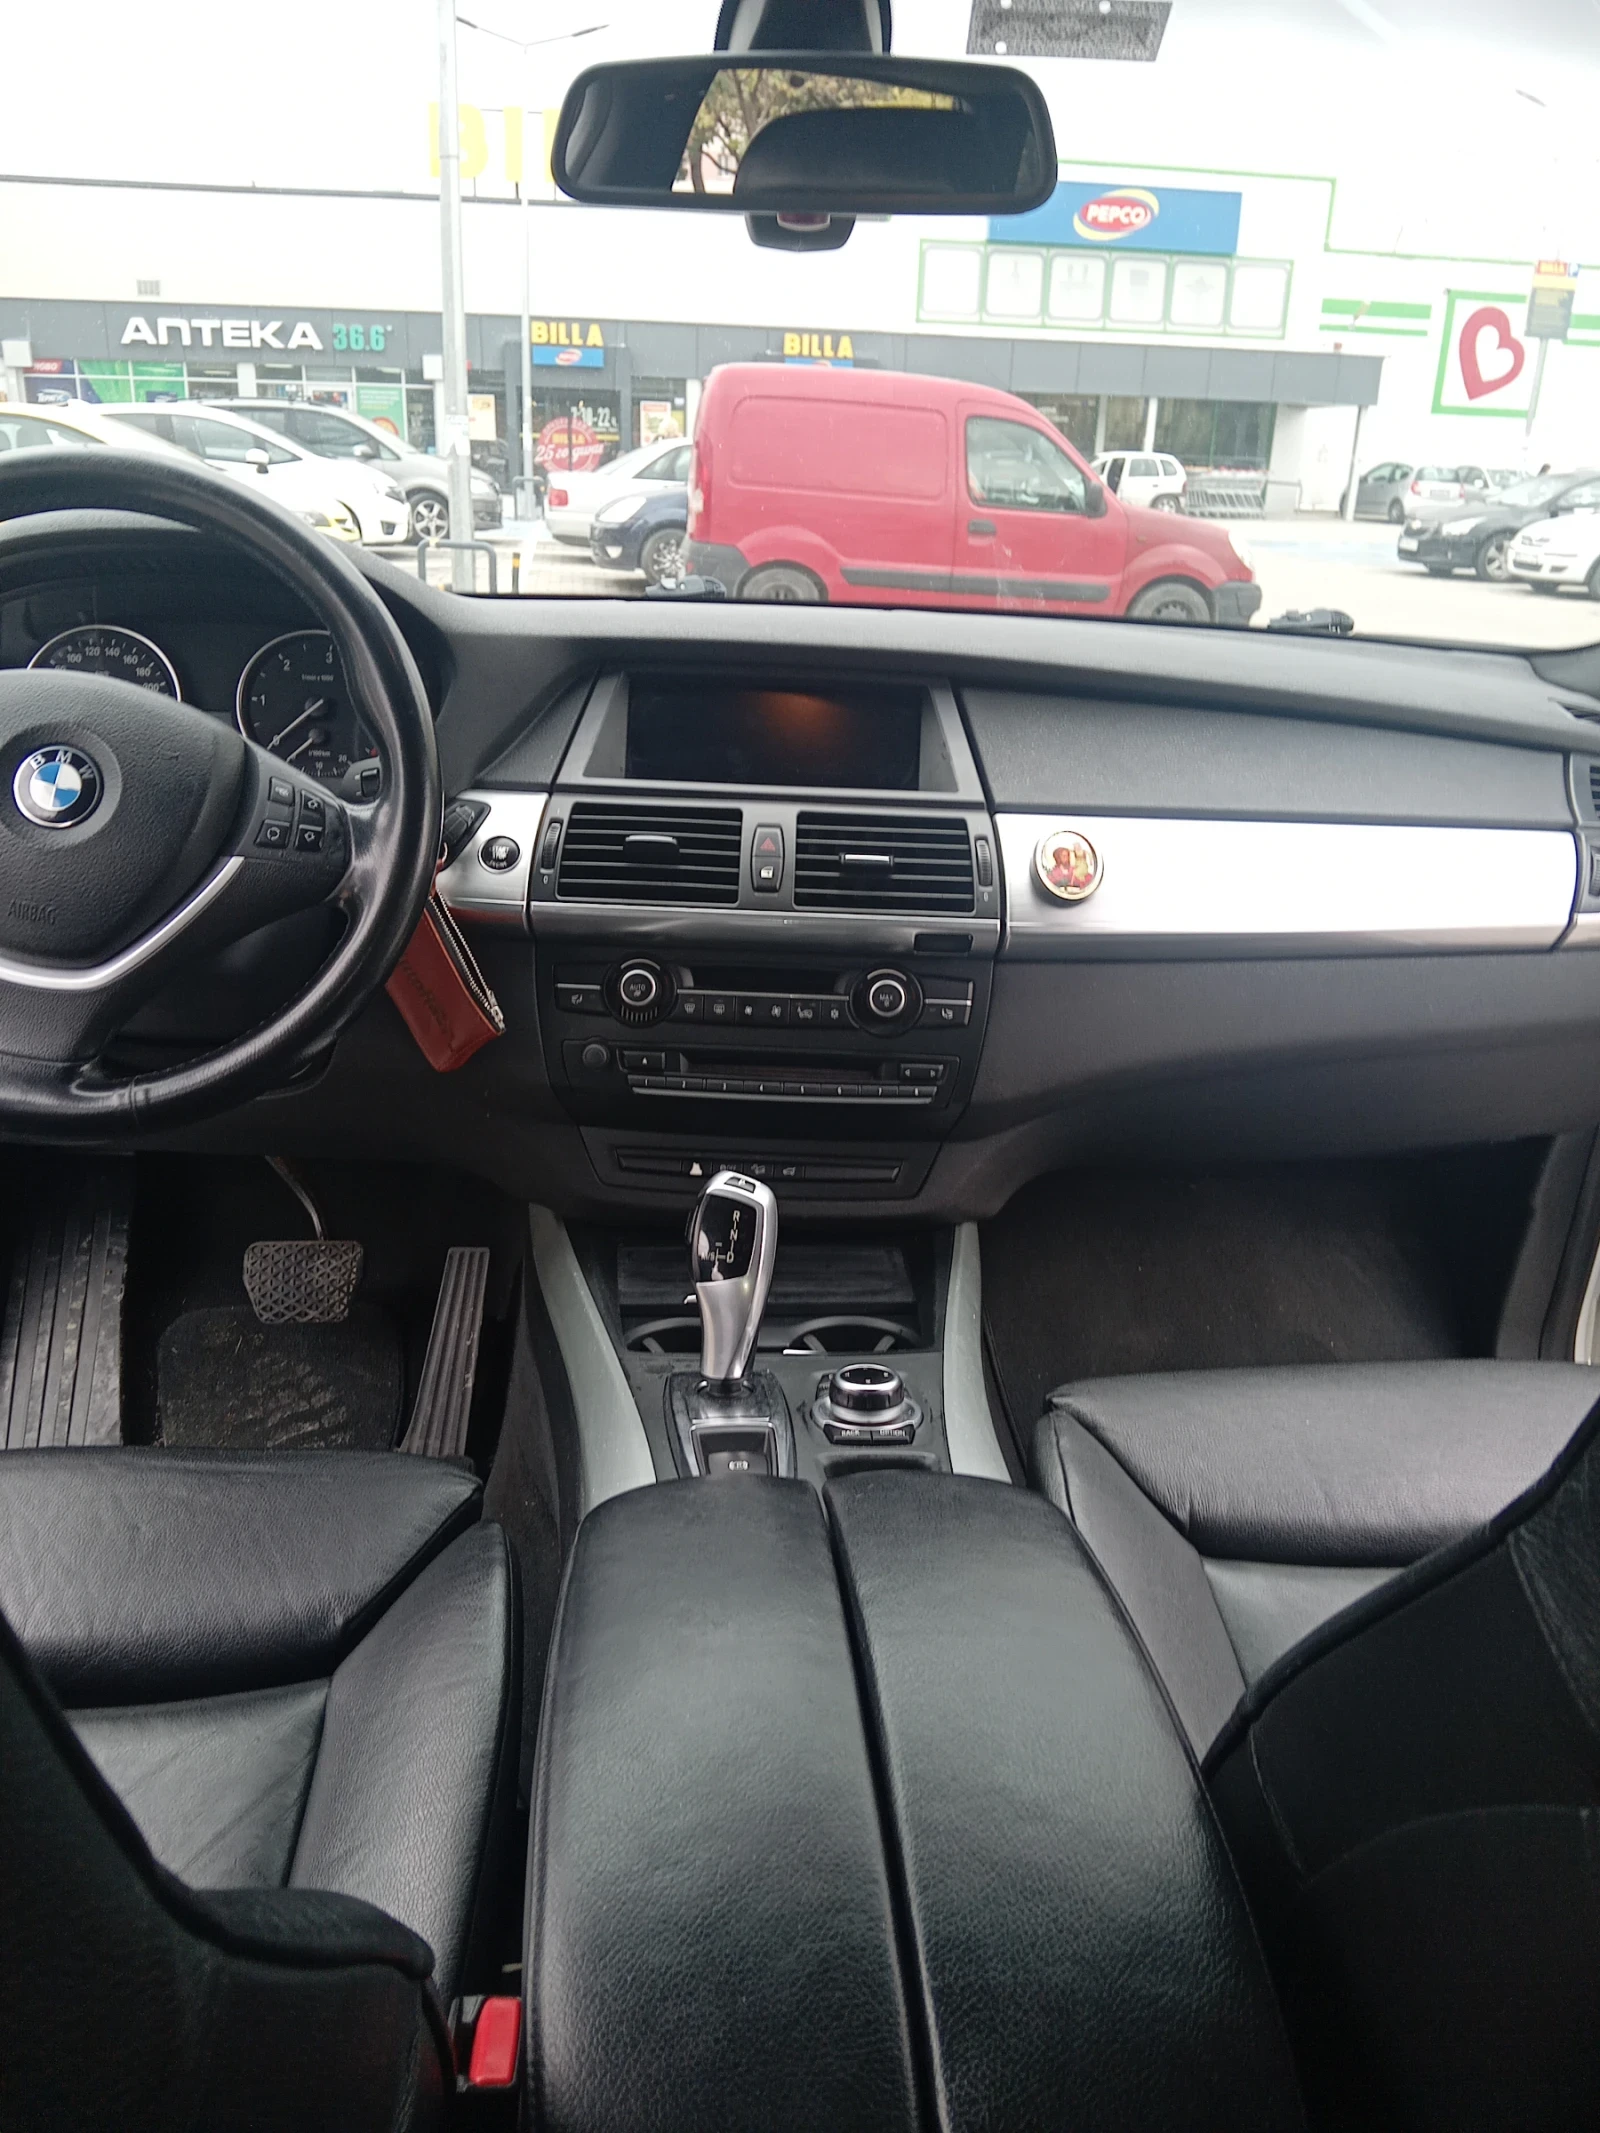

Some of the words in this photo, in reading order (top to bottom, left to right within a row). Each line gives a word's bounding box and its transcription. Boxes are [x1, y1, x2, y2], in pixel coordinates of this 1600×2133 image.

[1086, 203, 1146, 225] PEPCO
[120, 317, 323, 351] АПТЕКА
[531, 320, 604, 347] BILLA
[783, 332, 854, 359] BILLA
[534, 443, 556, 462] 25
[85, 646, 100, 657] 120
[104, 647, 120, 657] 140
[67, 653, 82, 663] 100
[123, 655, 138, 665] 160
[325, 652, 334, 664] 3
[283, 659, 291, 671] 2
[135, 667, 151, 677] 180
[338, 754, 348, 763] 20
[29, 750, 95, 780] BMW
[315, 761, 323, 770] 10
[879, 993, 893, 1001] MAX
[733, 1210, 740, 1222] R
[730, 1229, 738, 1241] N
[726, 1251, 735, 1263] D
[841, 1429, 860, 1437] BACK
